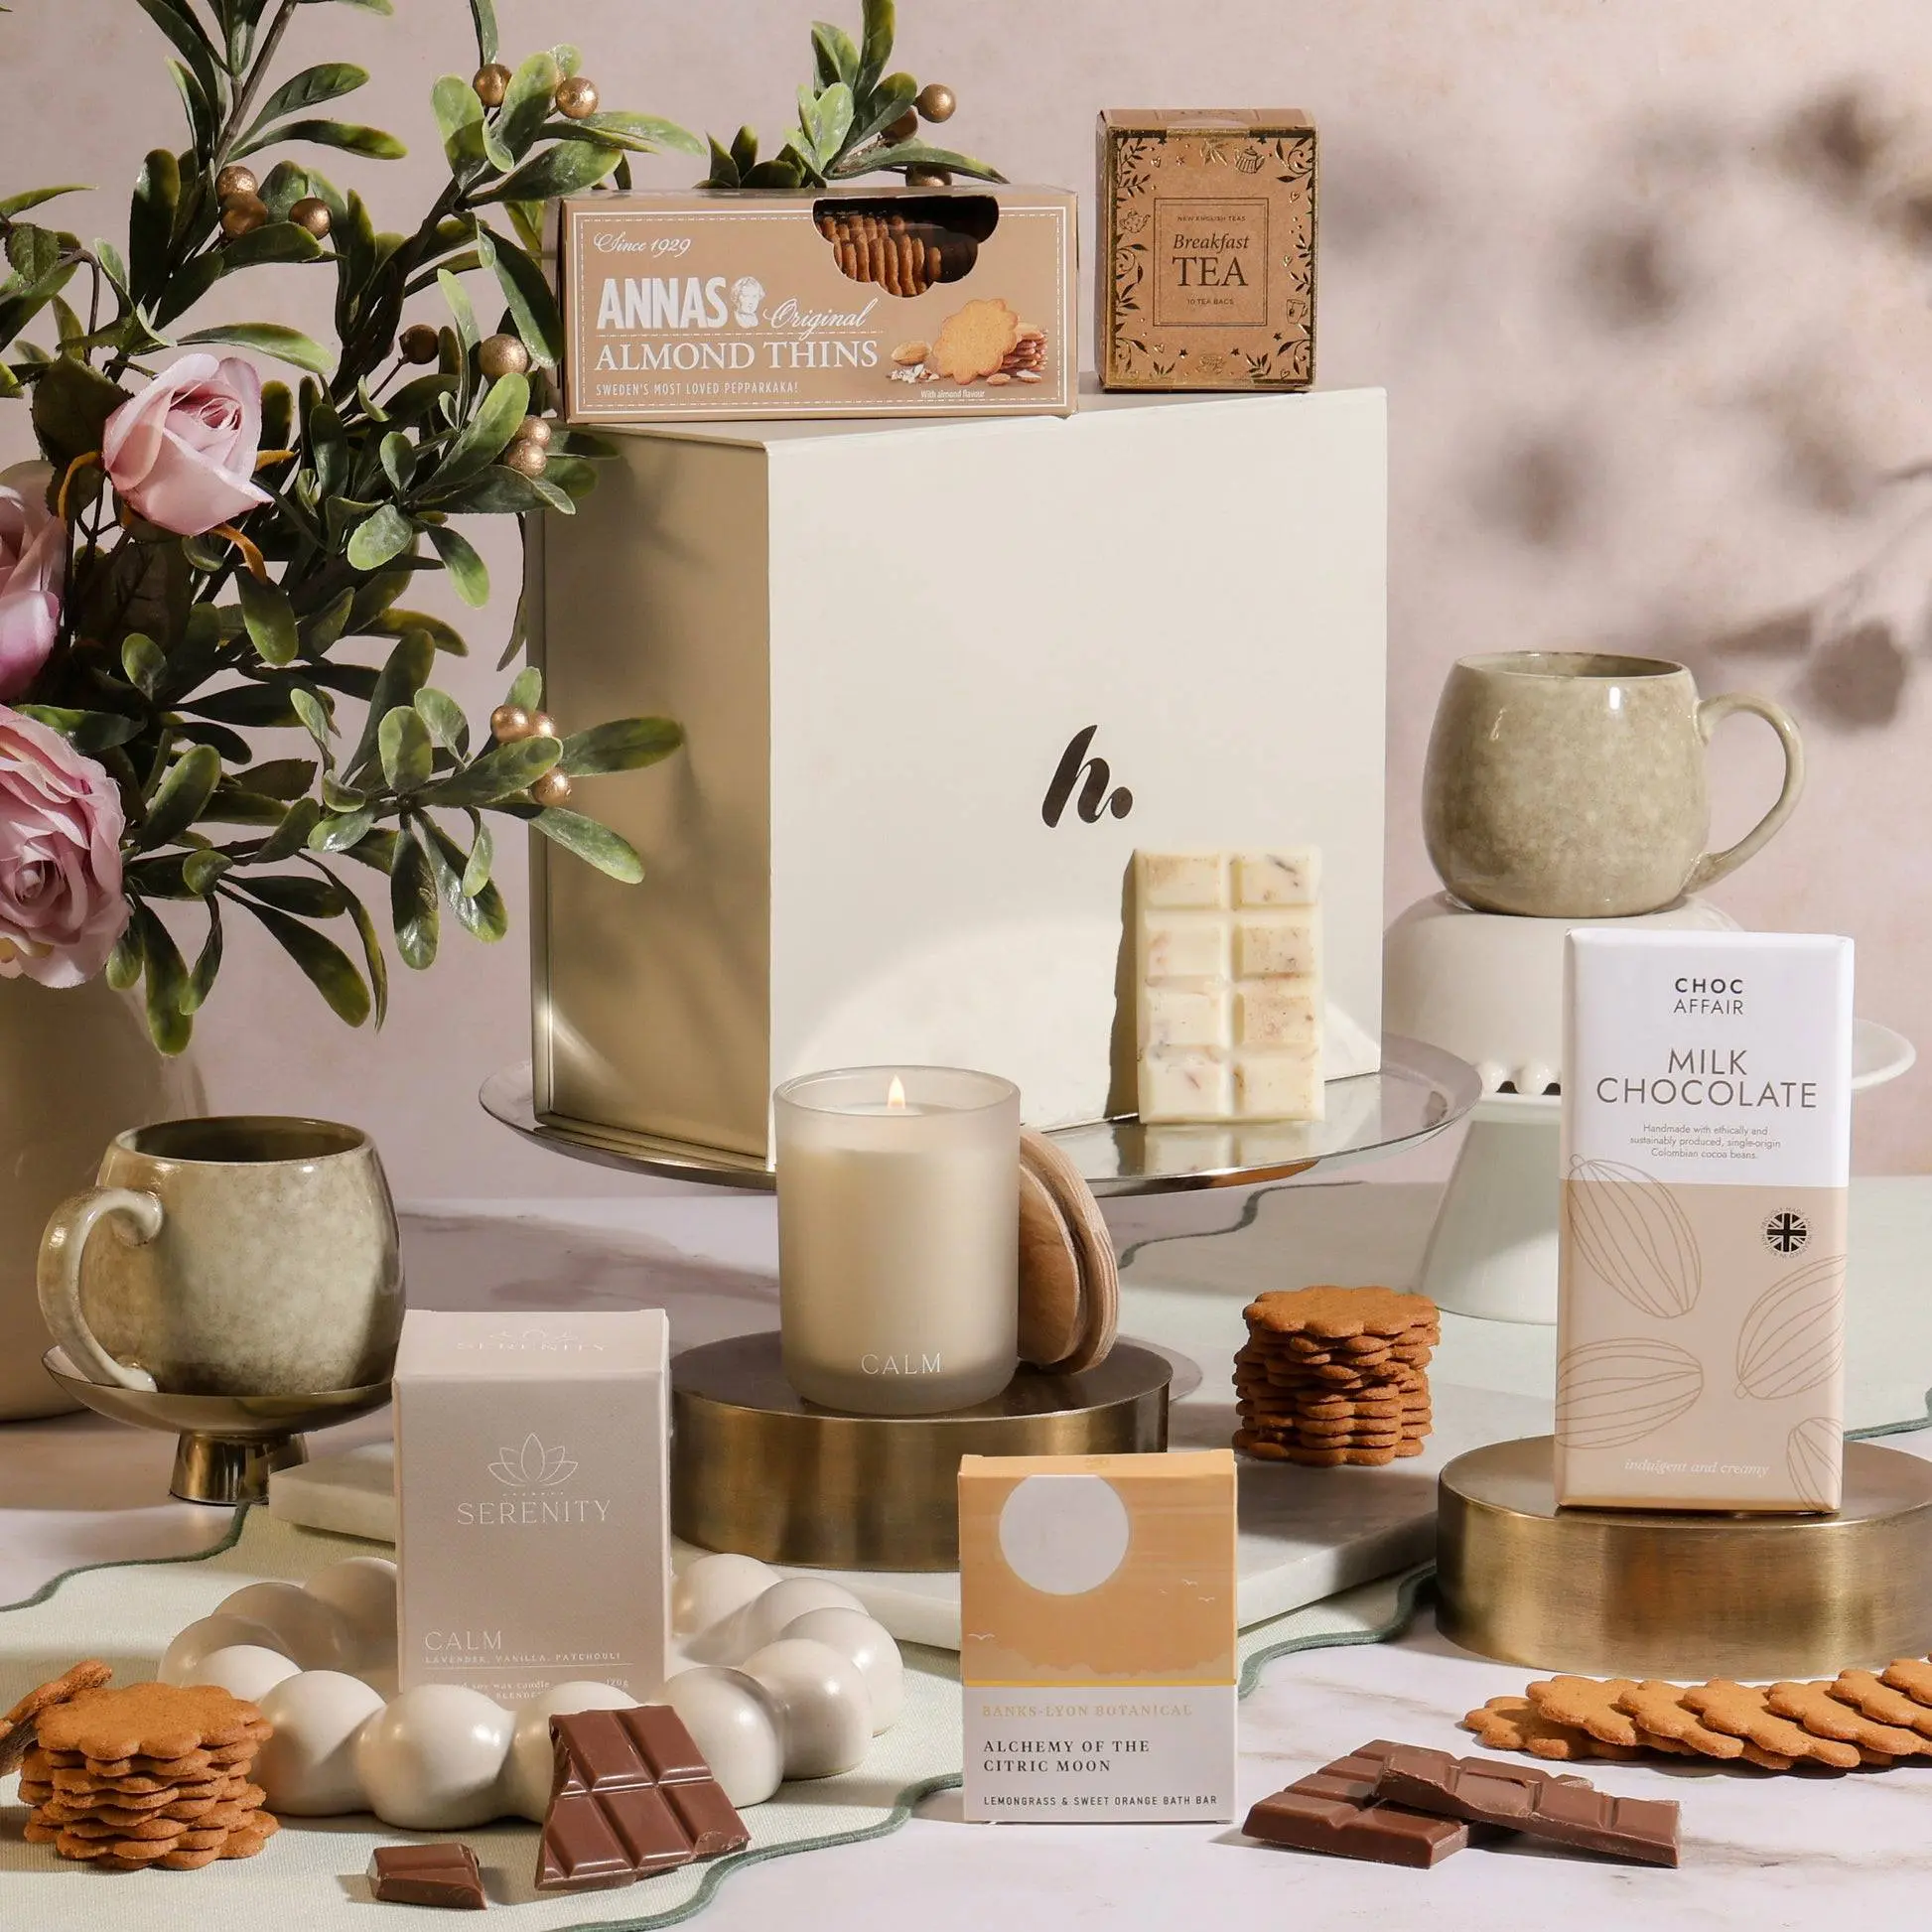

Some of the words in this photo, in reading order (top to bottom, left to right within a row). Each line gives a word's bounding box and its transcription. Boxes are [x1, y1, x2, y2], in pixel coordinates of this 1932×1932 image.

[594, 231, 645, 253] Since
[650, 237, 692, 258] 1929
[1173, 231, 1251, 254] Breakfast
[1172, 256, 1249, 287] TEA
[596, 276, 728, 330] ANNAS
[762, 297, 879, 341] Original
[594, 342, 756, 371] ALMOND
[762, 340, 879, 368] THINS
[596, 382, 650, 396] SWEDEN'S
[653, 382, 682, 396] MOST
[686, 381, 720, 395] LOVED
[724, 381, 798, 394] PEPPARKAKA!
[1675, 978, 1743, 995] CHOC
[1673, 999, 1744, 1015] AFFAIR
[1668, 1048, 1747, 1075] MILK
[1596, 1077, 1818, 1108] CHOCOLATE
[1643, 1124, 1691, 1134] Handmade
[1694, 1125, 1712, 1135] with
[1714, 1125, 1748, 1137] ethically
[1751, 1126, 1768, 1136] and
[1630, 1136, 1676, 1147] sustainably
[1679, 1137, 1725, 1149] produced,
[1727, 1139, 1781, 1150] single-origin
[1651, 1148, 1699, 1158] Colombian
[1701, 1150, 1727, 1159] cocoa
[860, 1352, 943, 1375] CALM
[1691, 1461, 1719, 1473] and
[1721, 1463, 1771, 1478] creamy
[457, 1499, 611, 1525] SERENITY
[425, 1630, 502, 1651] CALM
[555, 1652, 621, 1662] PATCHOULI
[515, 1680, 550, 1690] candle
[1096, 1704, 1193, 1717] BOTANICAL
[983, 1740, 1074, 1753] ALCHEMY
[1082, 1740, 1105, 1752] OF
[1112, 1739, 1150, 1752] THE
[983, 1759, 1049, 1772] CITRIC
[1056, 1759, 1111, 1772] MOON
[984, 1796, 1056, 1806] LEMONGRASS
[1073, 1796, 1109, 1806] SWEET
[1114, 1796, 1158, 1806] ORANGE
[1163, 1795, 1190, 1805] BATH
[1195, 1794, 1218, 1805] BAR
